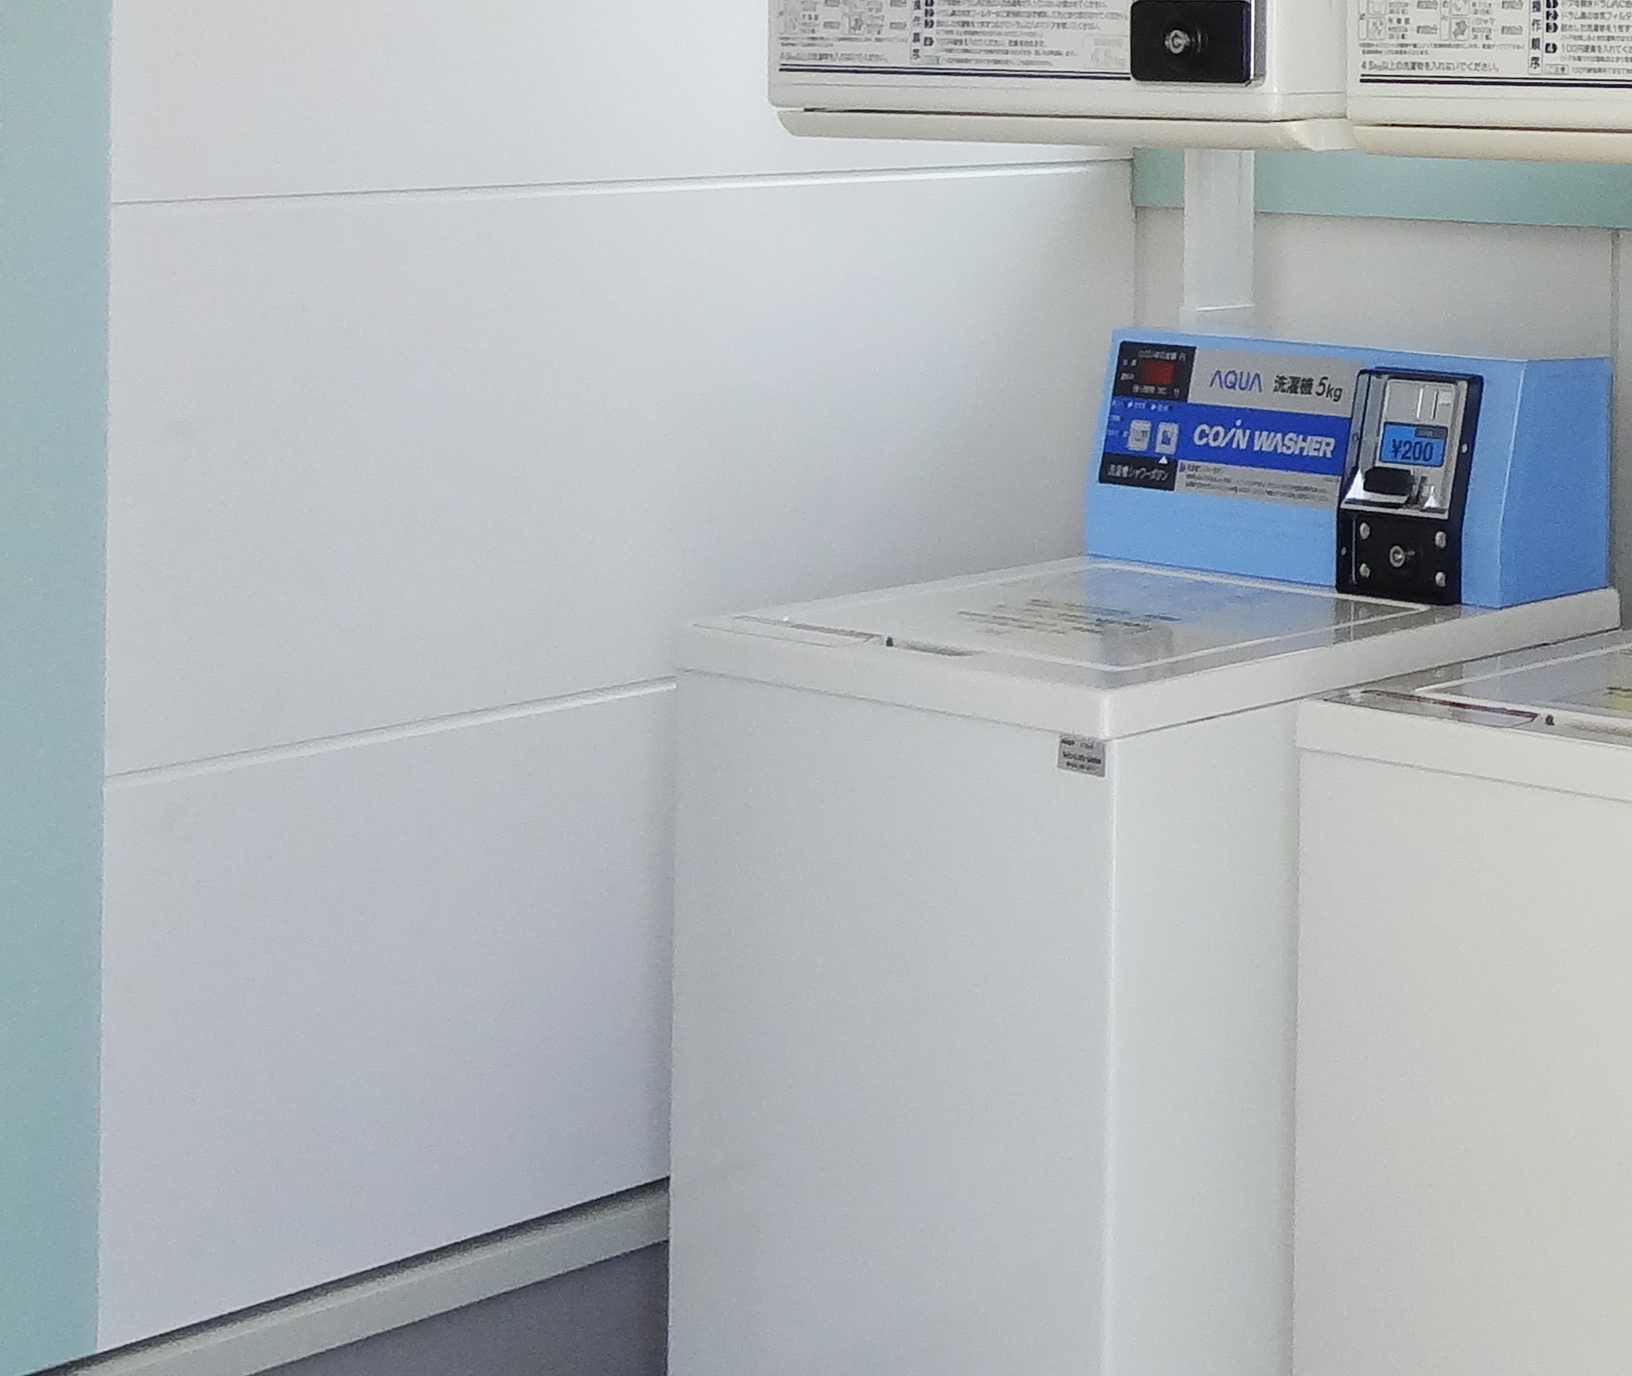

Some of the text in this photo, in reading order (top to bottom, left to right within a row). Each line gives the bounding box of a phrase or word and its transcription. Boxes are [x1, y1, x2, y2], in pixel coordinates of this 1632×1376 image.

[1209, 370, 1263, 392] AQUA
[1273, 375, 1343, 402] 洗濯機 5kg
[1254, 430, 1335, 458] WASHER
